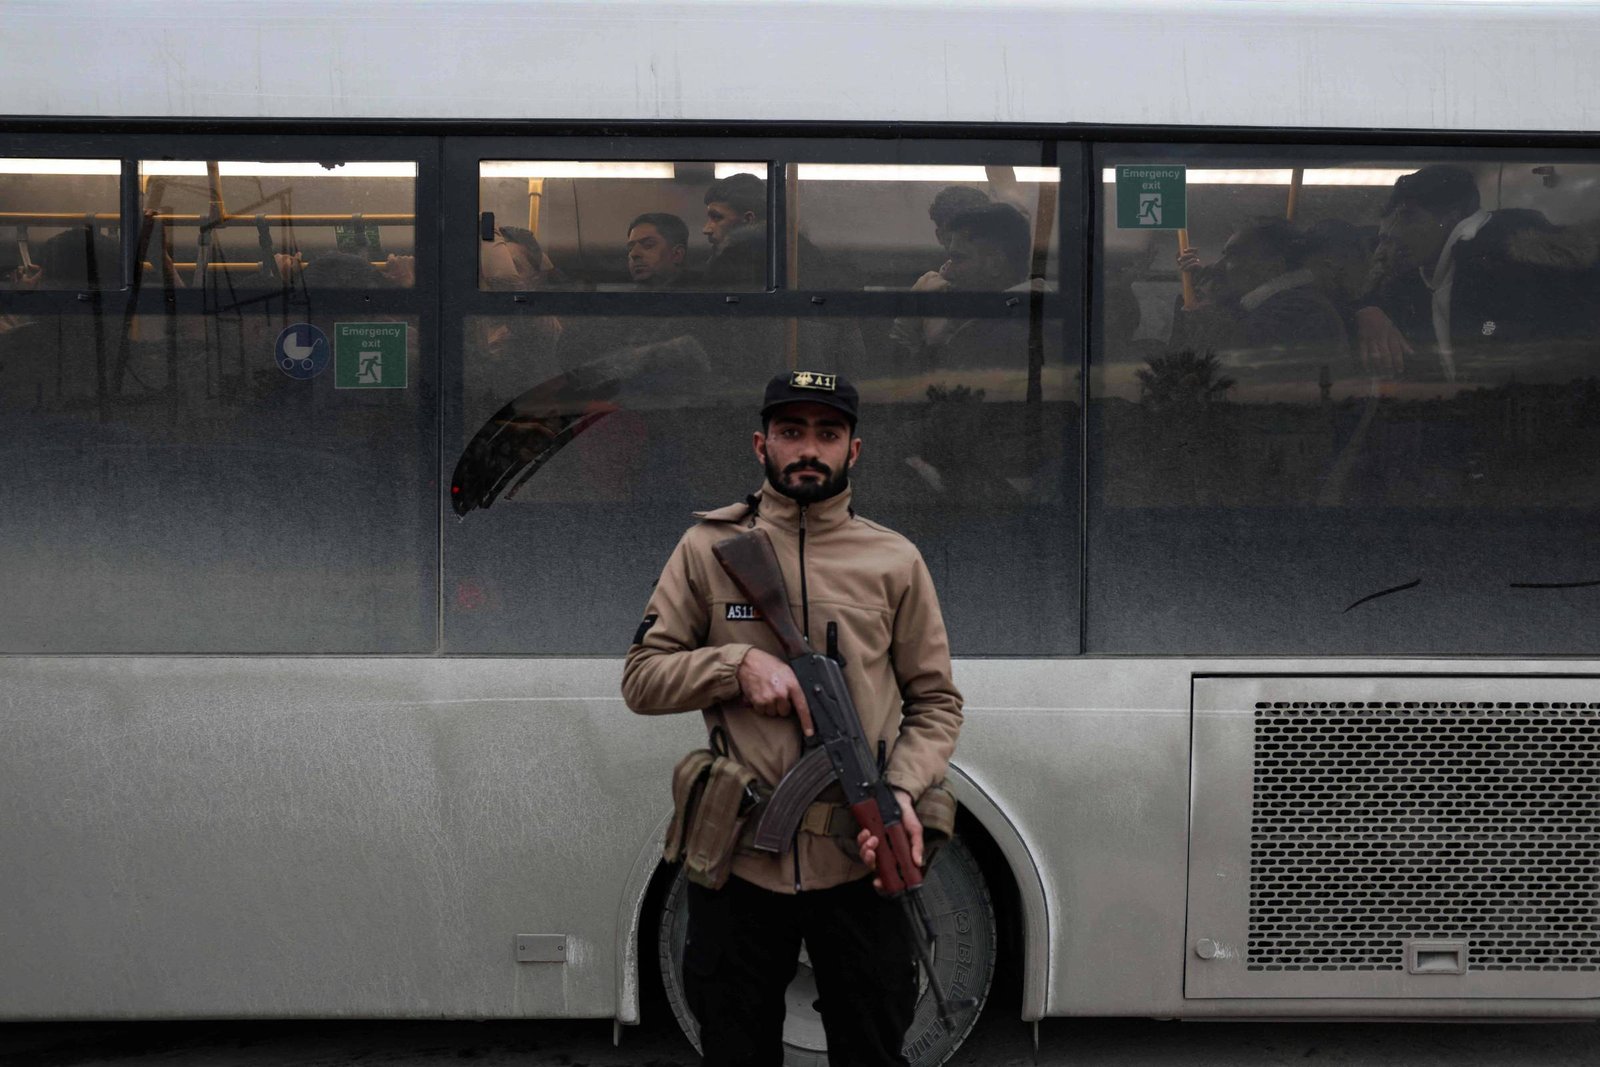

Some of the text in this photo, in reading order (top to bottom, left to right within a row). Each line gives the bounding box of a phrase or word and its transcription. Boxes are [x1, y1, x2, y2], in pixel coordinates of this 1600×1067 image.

[1122, 168, 1180, 180] Emergency
[1142, 181, 1161, 190] exit
[342, 326, 401, 338] Emergency
[361, 339, 381, 348] exit
